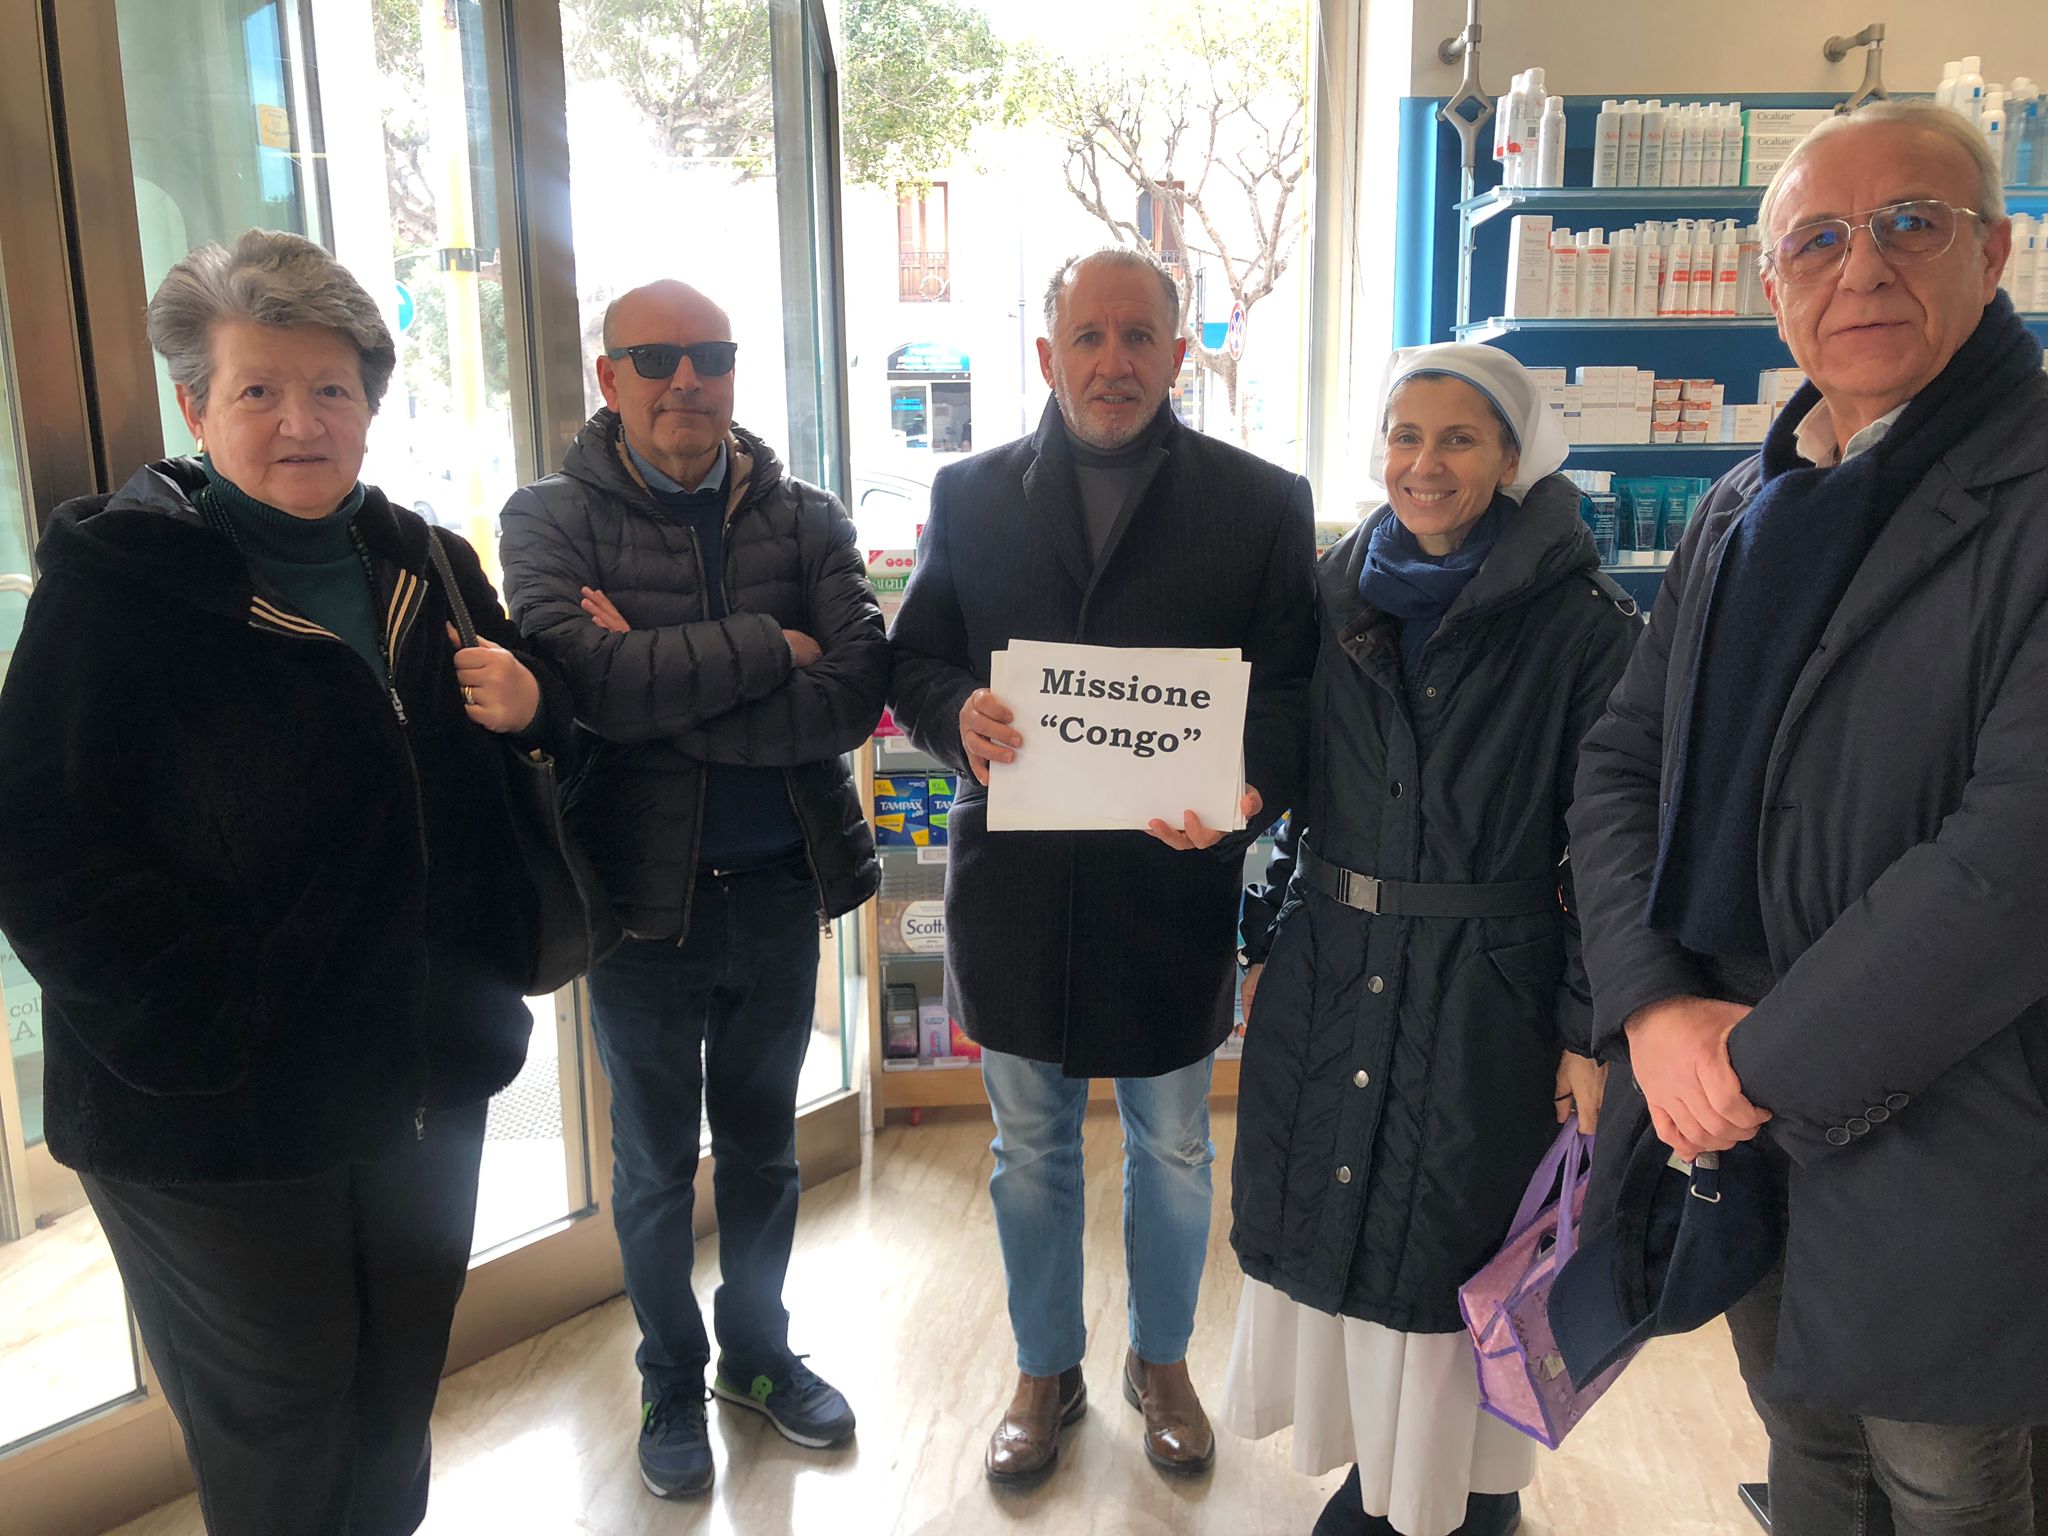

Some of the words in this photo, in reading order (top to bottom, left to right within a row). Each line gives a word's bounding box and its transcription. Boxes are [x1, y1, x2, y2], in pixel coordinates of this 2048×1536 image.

[1040, 668, 1211, 709] Missione
[1040, 714, 1202, 758] “Congo”
[880, 801, 922, 811] TAMPAX
